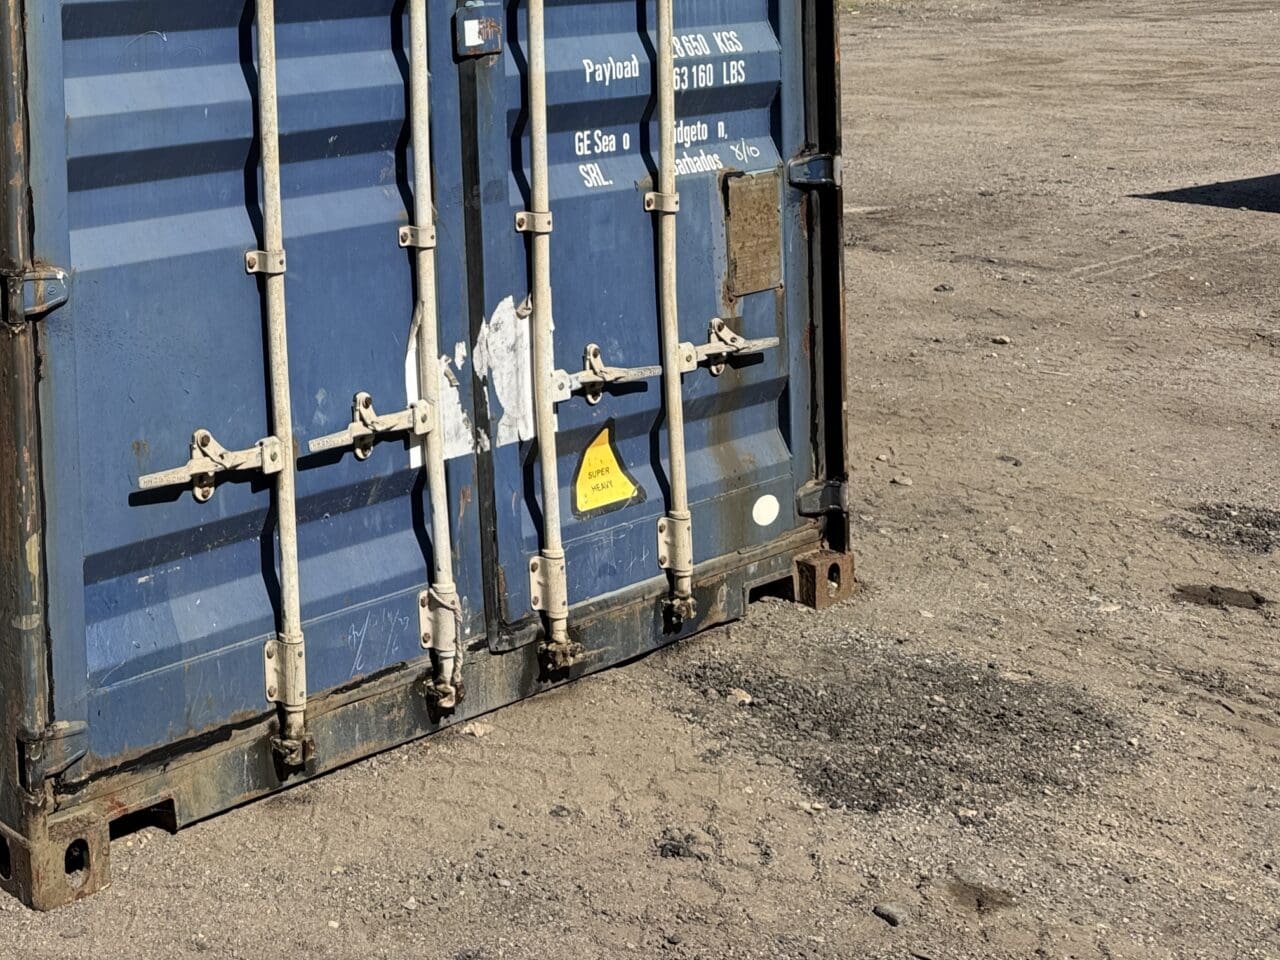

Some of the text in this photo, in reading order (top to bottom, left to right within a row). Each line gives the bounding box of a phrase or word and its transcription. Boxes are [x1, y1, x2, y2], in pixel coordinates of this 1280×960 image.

[712, 30, 744, 54] KGS
[583, 54, 640, 86] Payload
[723, 59, 746, 85] LBS
[575, 130, 592, 156] GE
[578, 162, 614, 188] SRL.
[587, 466, 611, 480] SUPER
[590, 481, 615, 494] HEAVY
